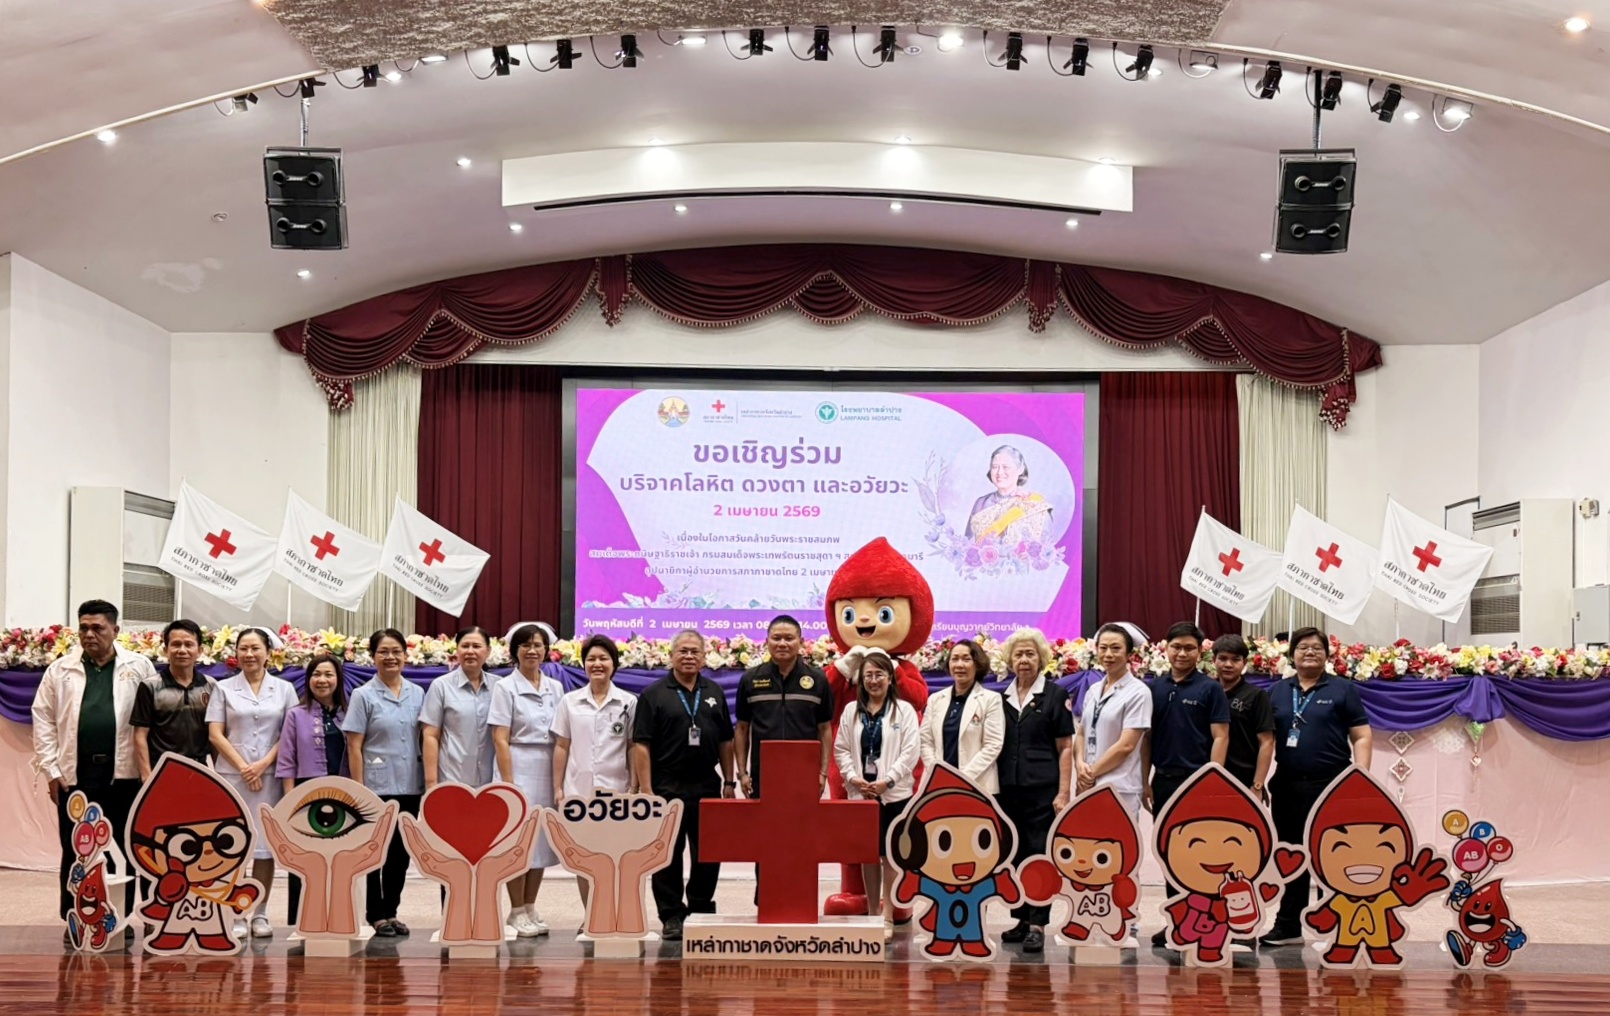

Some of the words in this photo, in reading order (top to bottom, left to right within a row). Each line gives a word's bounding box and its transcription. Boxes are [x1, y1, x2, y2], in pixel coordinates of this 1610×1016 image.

[694, 437, 842, 469] ขอเชิญร่วม
[620, 472, 734, 492] บริจาคโลหิต
[742, 477, 805, 493] ดวงตา
[814, 475, 908, 494] และอวัยวะ
[714, 505, 722, 516] 2
[728, 506, 778, 517] เมษายน
[783, 506, 820, 517] 2569
[677, 531, 840, 544] เนื่องในโอกาสวันคล้ายวันพระราชสมภพ
[174, 546, 238, 586] สภากาชาดไทย
[184, 564, 194, 572] RED
[195, 570, 210, 581] CROSS
[212, 580, 232, 591] SOCIETY
[286, 549, 344, 587] สภากาชาดไทย
[395, 554, 450, 593] สภากาชาดไทย
[800, 568, 807, 576] 2
[302, 572, 317, 582] CROSS
[318, 581, 339, 592] SOCIETY
[402, 570, 410, 578] RED
[411, 576, 424, 588] CROSS
[424, 586, 443, 598] SOCIETY
[1192, 567, 1245, 600] สภากาชาดไทย
[1287, 563, 1345, 600] สภากาชาดไทย
[1384, 561, 1447, 600] สภากาชาดไทย
[1393, 578, 1402, 586] RED
[1403, 584, 1417, 595] CROSS
[1418, 594, 1439, 605] SOCIETY
[1208, 587, 1221, 597] CROSS
[1221, 596, 1239, 606] SOCIETY
[1305, 584, 1319, 595] CROSS
[1320, 594, 1338, 606] SOCIETY
[582, 616, 644, 630] วันพฤหัสบดีที่
[650, 619, 656, 628] 2
[662, 620, 698, 629] เมษายน
[704, 620, 730, 629] 2569
[733, 621, 753, 630] เวลา
[564, 790, 662, 822] อวัยวะ
[1452, 818, 1459, 826] A
[1479, 828, 1486, 836] B
[81, 834, 89, 842] AB
[1464, 851, 1478, 859] AB
[176, 896, 213, 922] AB
[1078, 893, 1111, 917] AB
[1349, 904, 1375, 935] A
[686, 936, 881, 955] เหล่ากาชาดจังหวัดลำปาง
